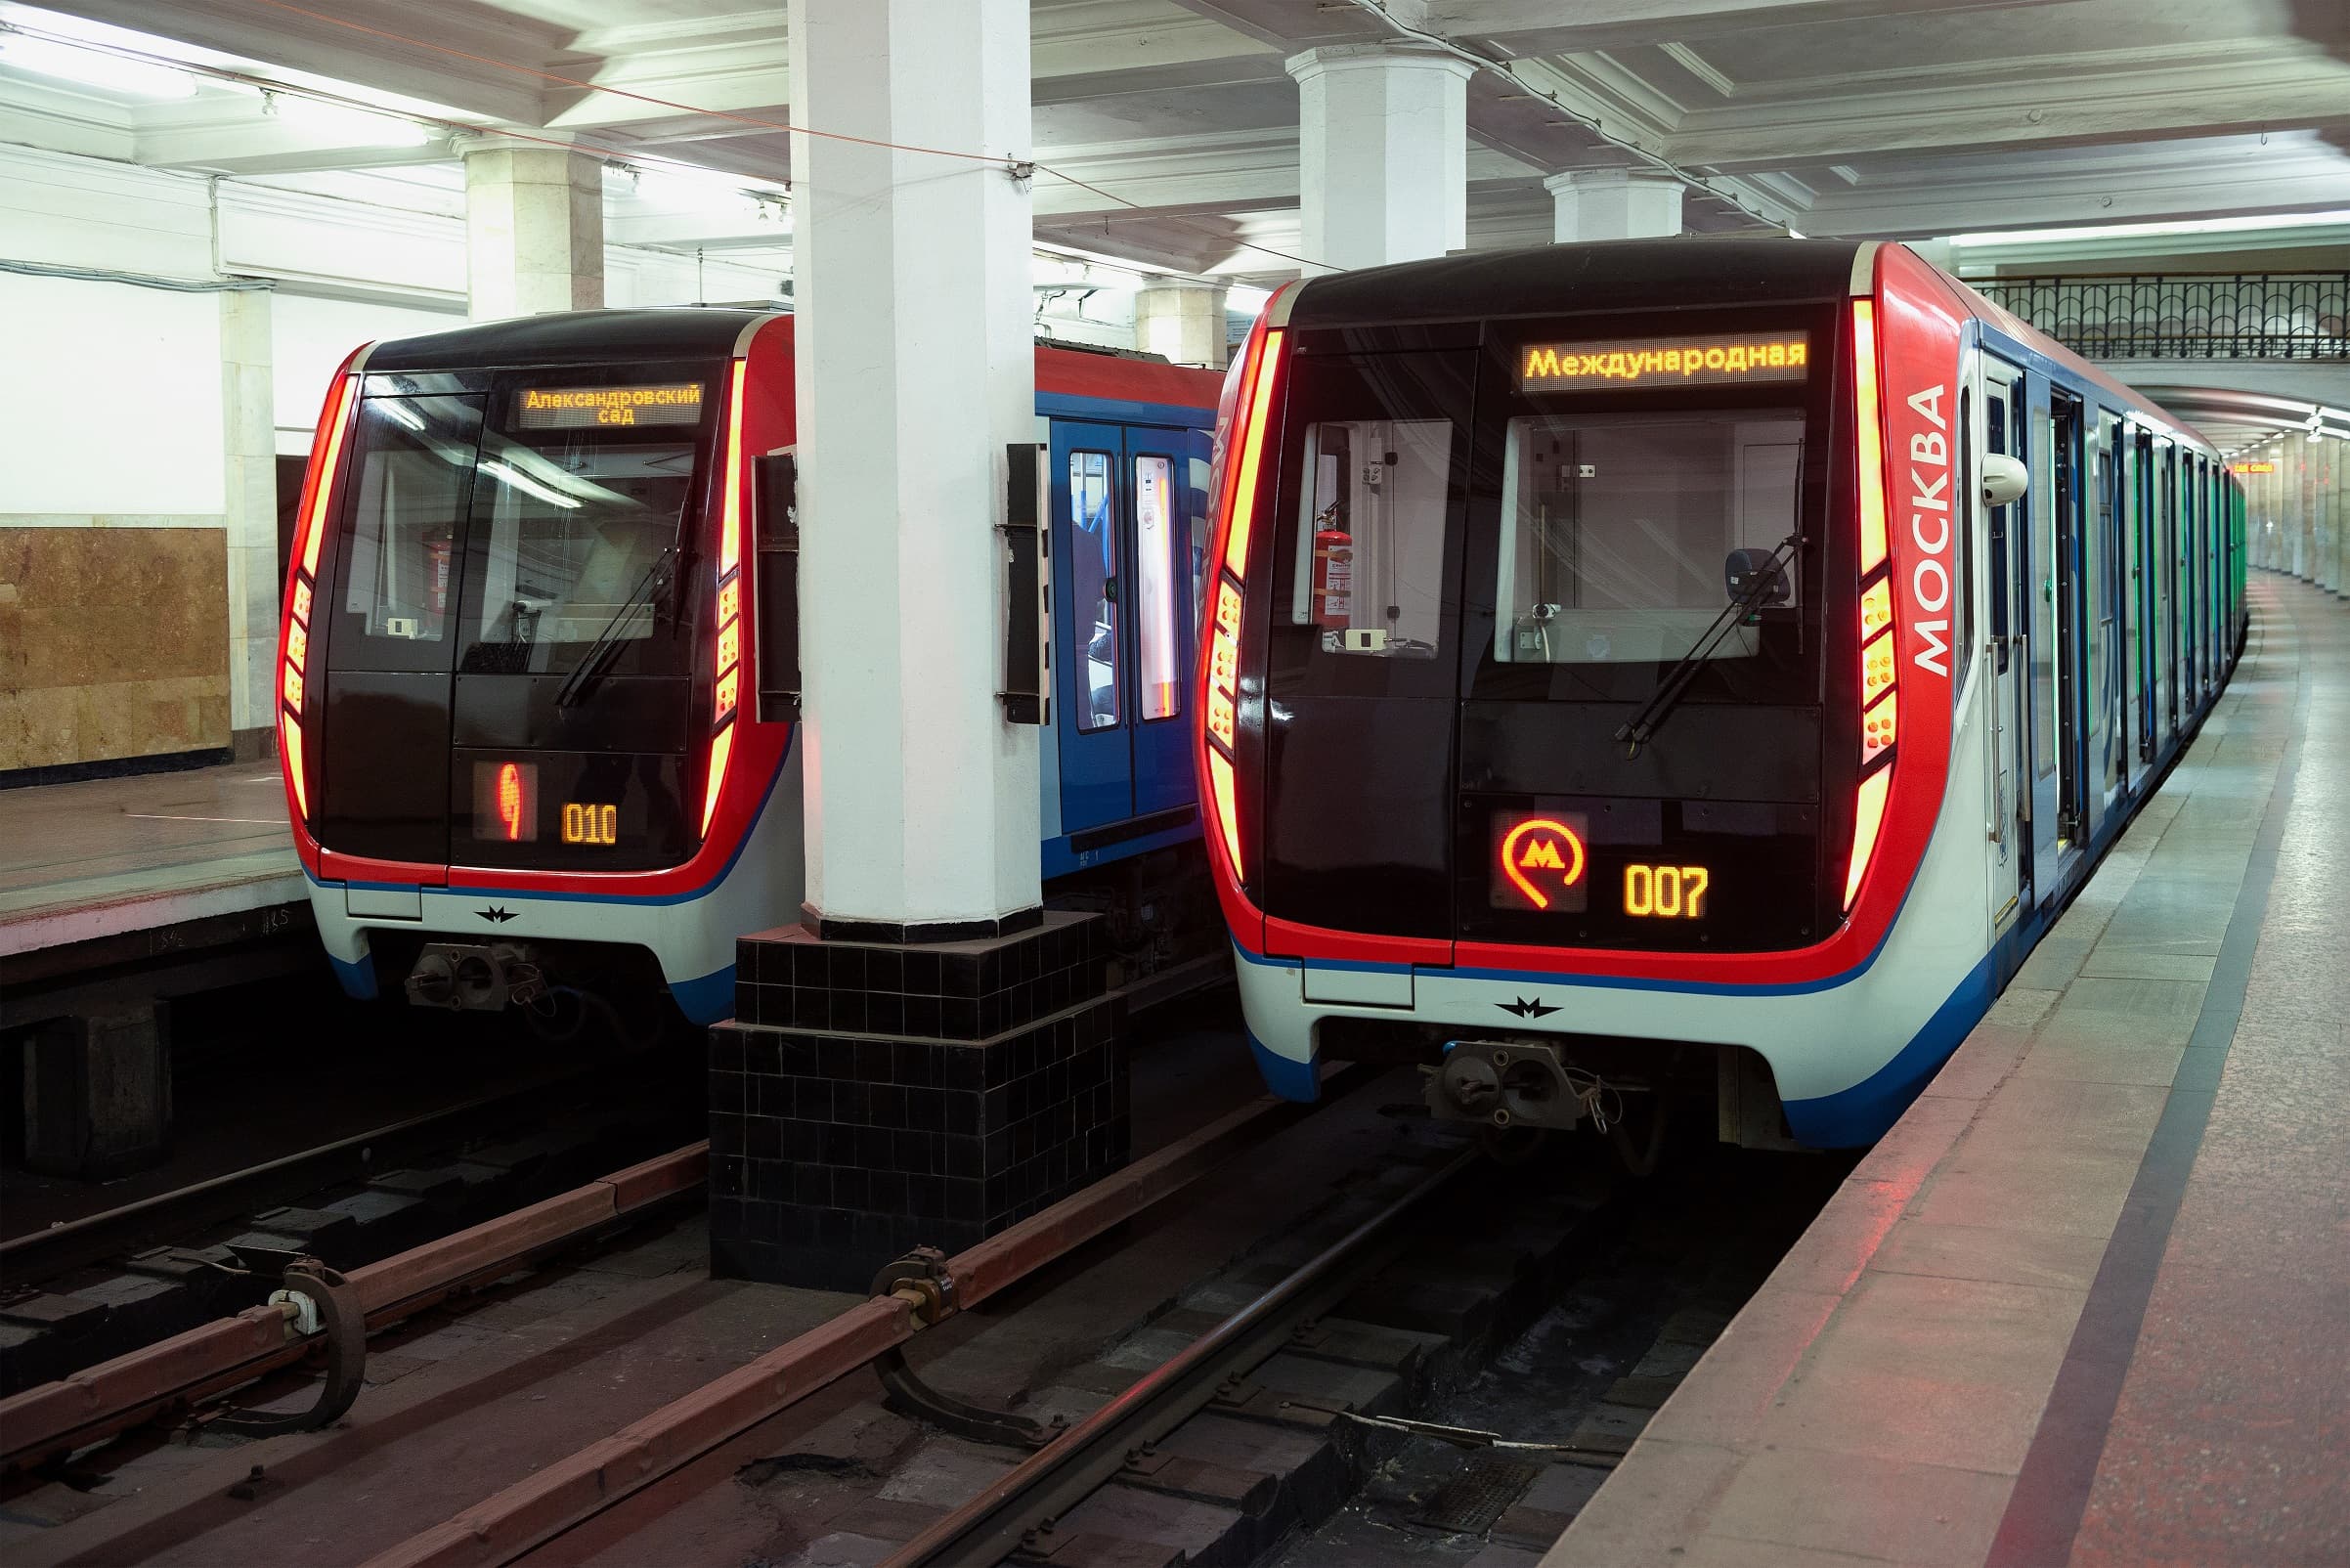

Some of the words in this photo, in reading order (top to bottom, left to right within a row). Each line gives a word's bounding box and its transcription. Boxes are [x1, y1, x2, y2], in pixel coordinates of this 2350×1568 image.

[1525, 343, 1807, 378] Международная
[526, 383, 700, 410] Александровский
[598, 409, 634, 425] сад
[1907, 384, 1949, 677] МОСКВА
[566, 804, 617, 845] 010
[1625, 864, 1709, 917] 007
